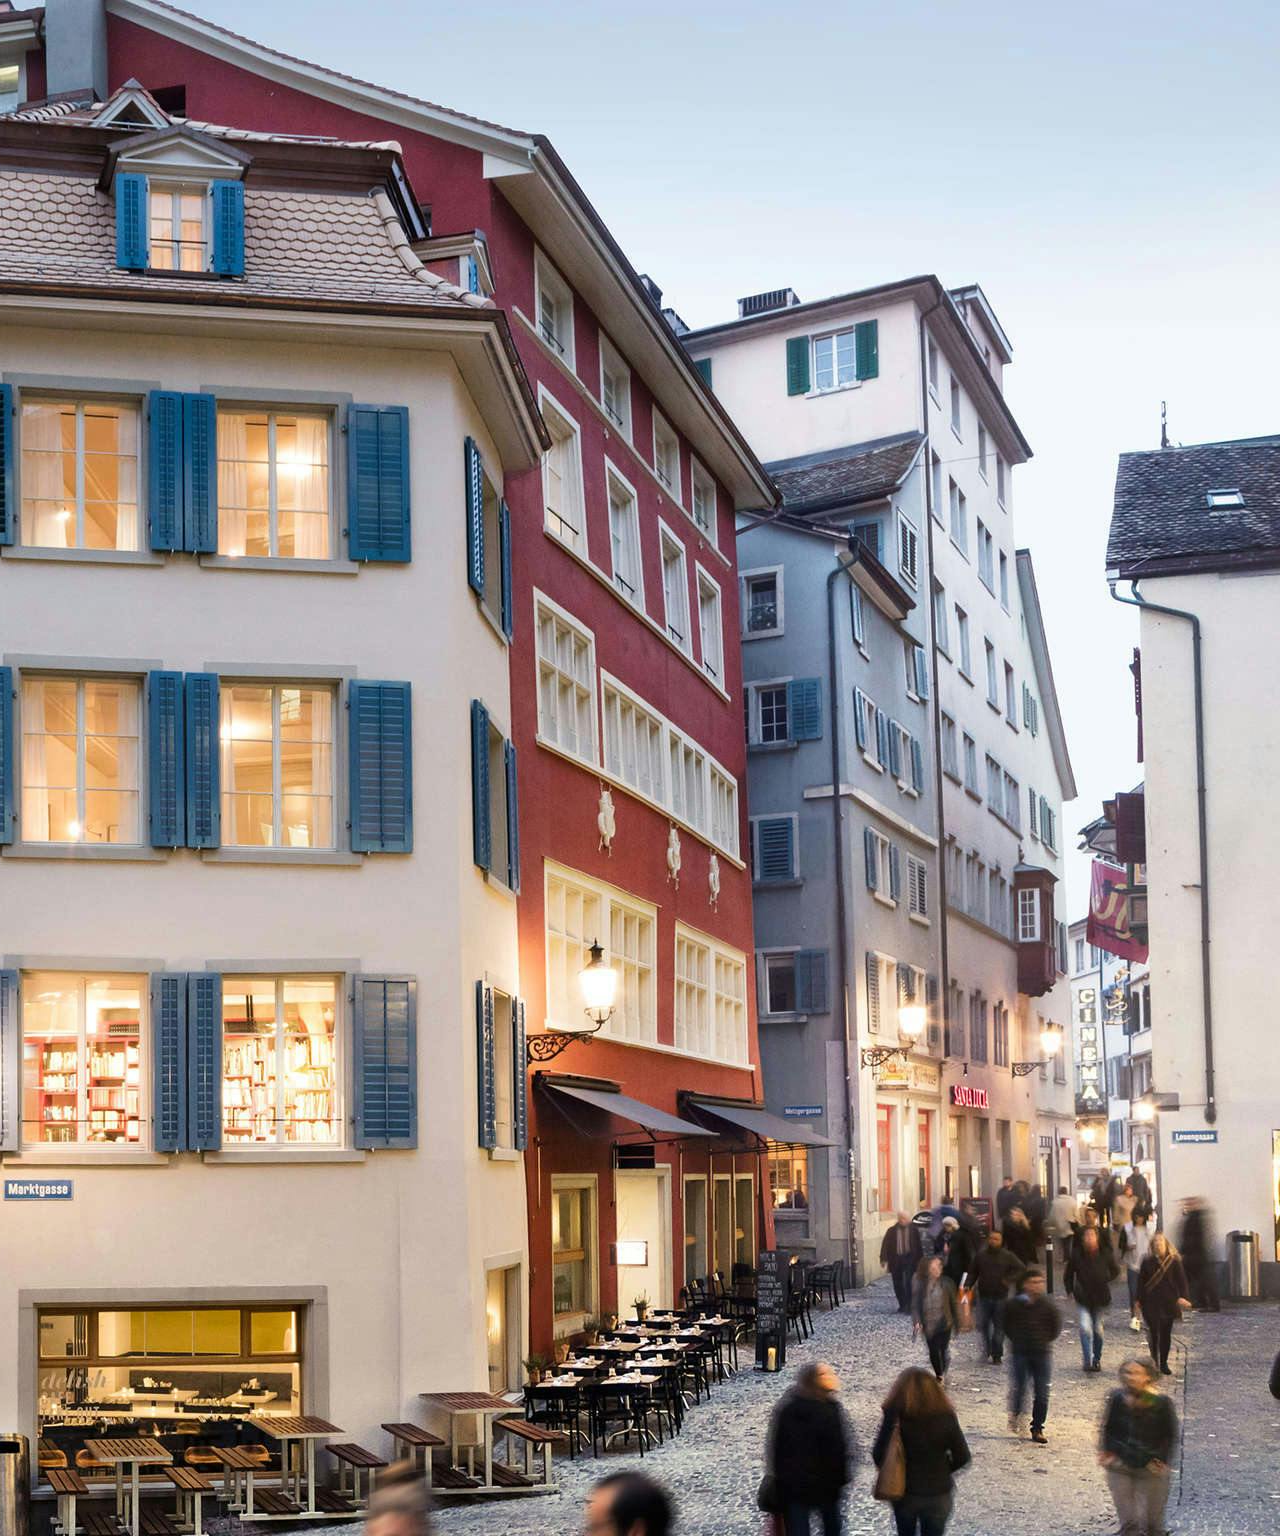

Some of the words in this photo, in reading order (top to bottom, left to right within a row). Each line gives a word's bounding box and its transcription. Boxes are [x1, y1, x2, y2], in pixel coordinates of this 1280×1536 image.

[1080, 988, 1099, 1099] CINEMA
[954, 1085, 972, 1107] SANTA
[973, 1088, 990, 1109] LUCIA
[8, 1183, 68, 1197] Marktgasse
[41, 1368, 107, 1390] delish
